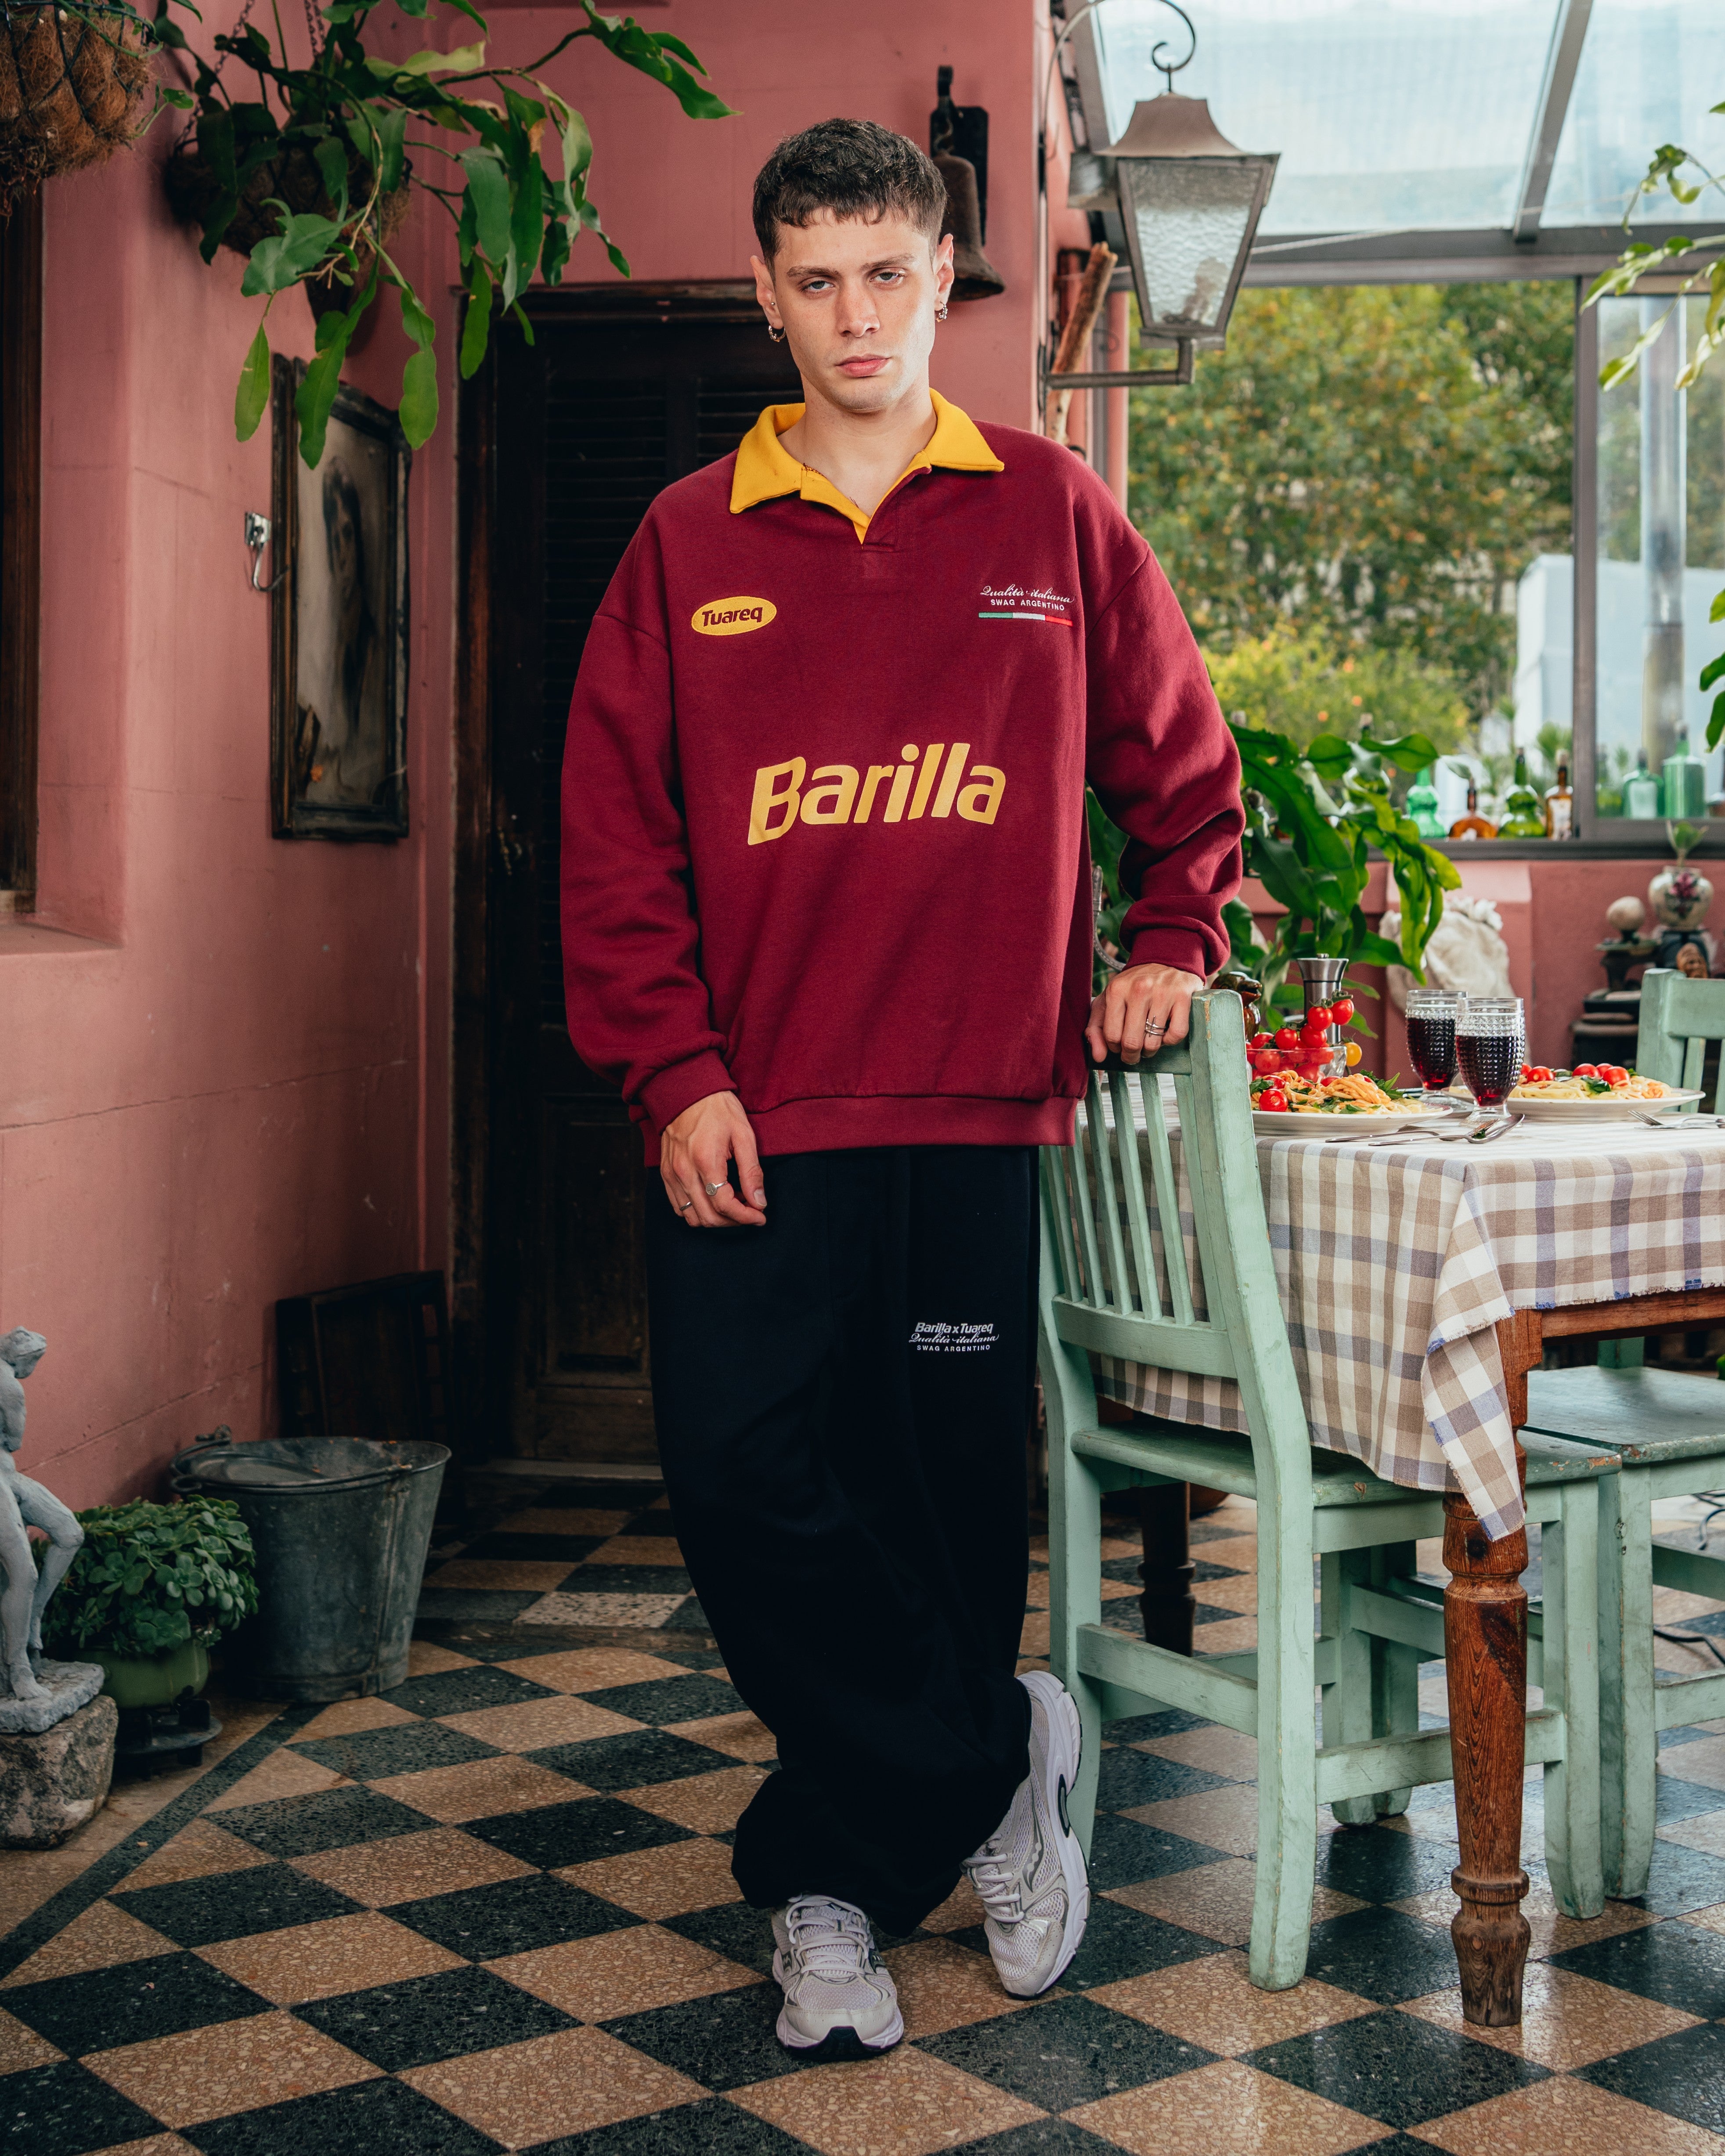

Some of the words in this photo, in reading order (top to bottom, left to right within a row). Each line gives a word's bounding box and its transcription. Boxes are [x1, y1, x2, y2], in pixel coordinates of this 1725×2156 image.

[980, 584, 1025, 596] Qualità
[1025, 588, 1075, 603] italiana
[1020, 600, 1065, 611] ARGENTINO
[747, 743, 1006, 845] Barilla
[915, 1322, 952, 1333] Barilla
[909, 1331, 950, 1343] Qualità
[952, 1330, 999, 1343] italiana
